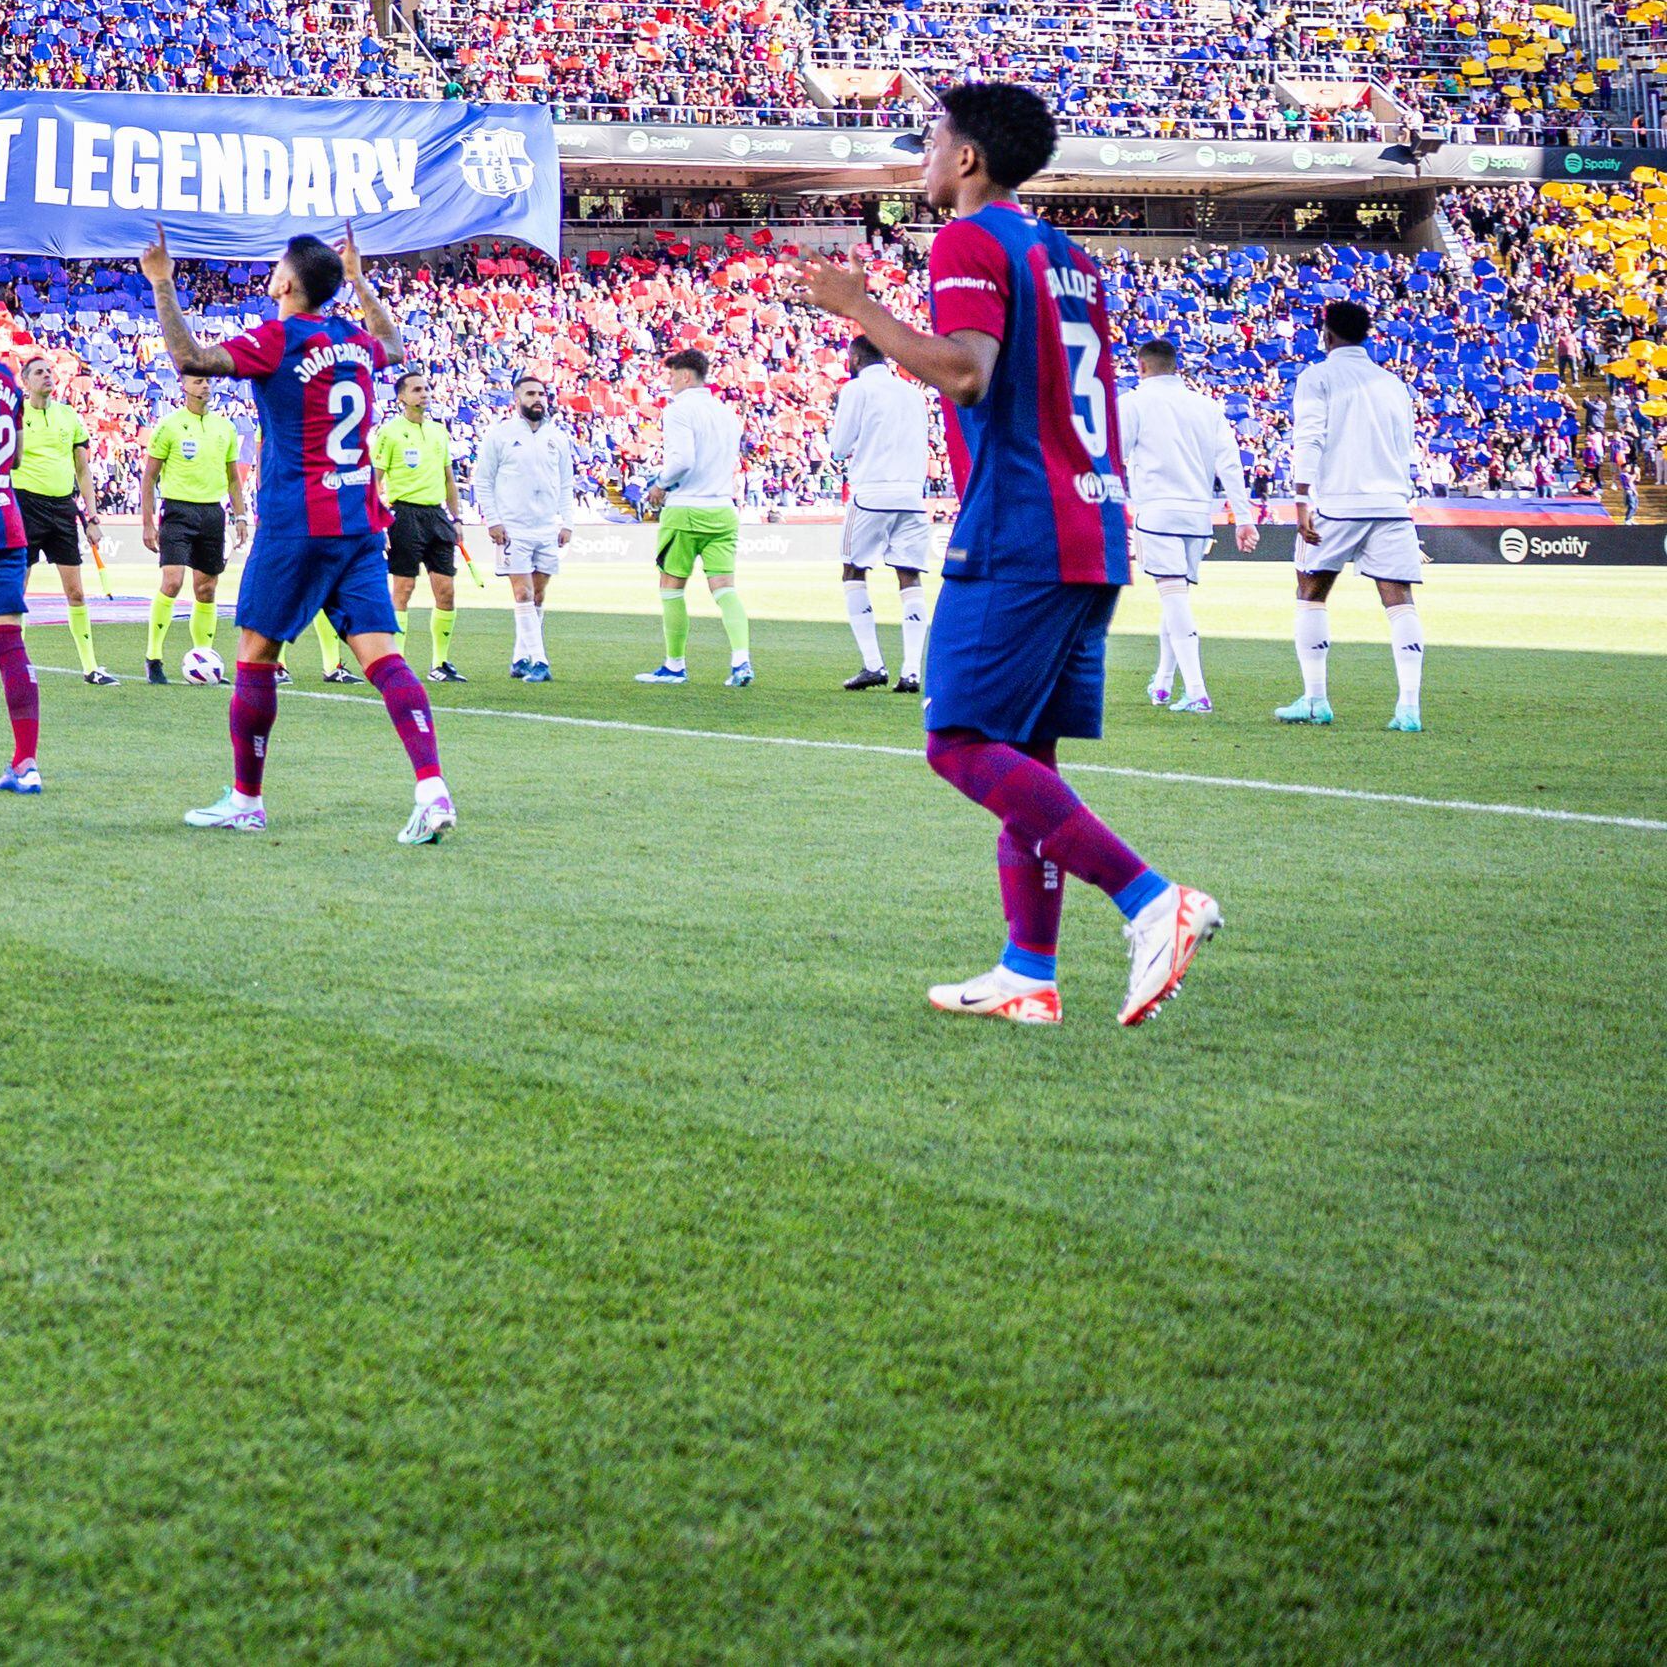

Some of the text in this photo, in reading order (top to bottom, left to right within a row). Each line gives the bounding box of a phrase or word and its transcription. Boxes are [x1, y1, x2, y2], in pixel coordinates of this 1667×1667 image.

[650, 136, 692, 151] Spotify
[751, 139, 792, 154] Spotify
[1120, 149, 1160, 163] Spotify
[1217, 151, 1257, 166] Spotify
[1314, 152, 1355, 167] Spotify
[1489, 156, 1530, 171] Spotify
[34, 117, 422, 217] LEGENDARY
[1584, 157, 1621, 172] Spotify
[293, 346, 335, 383] JOÃO
[1060, 321, 1107, 458] 3
[326, 380, 366, 465] 2
[571, 535, 631, 556] Spotify
[1530, 536, 1588, 559] Spotify
